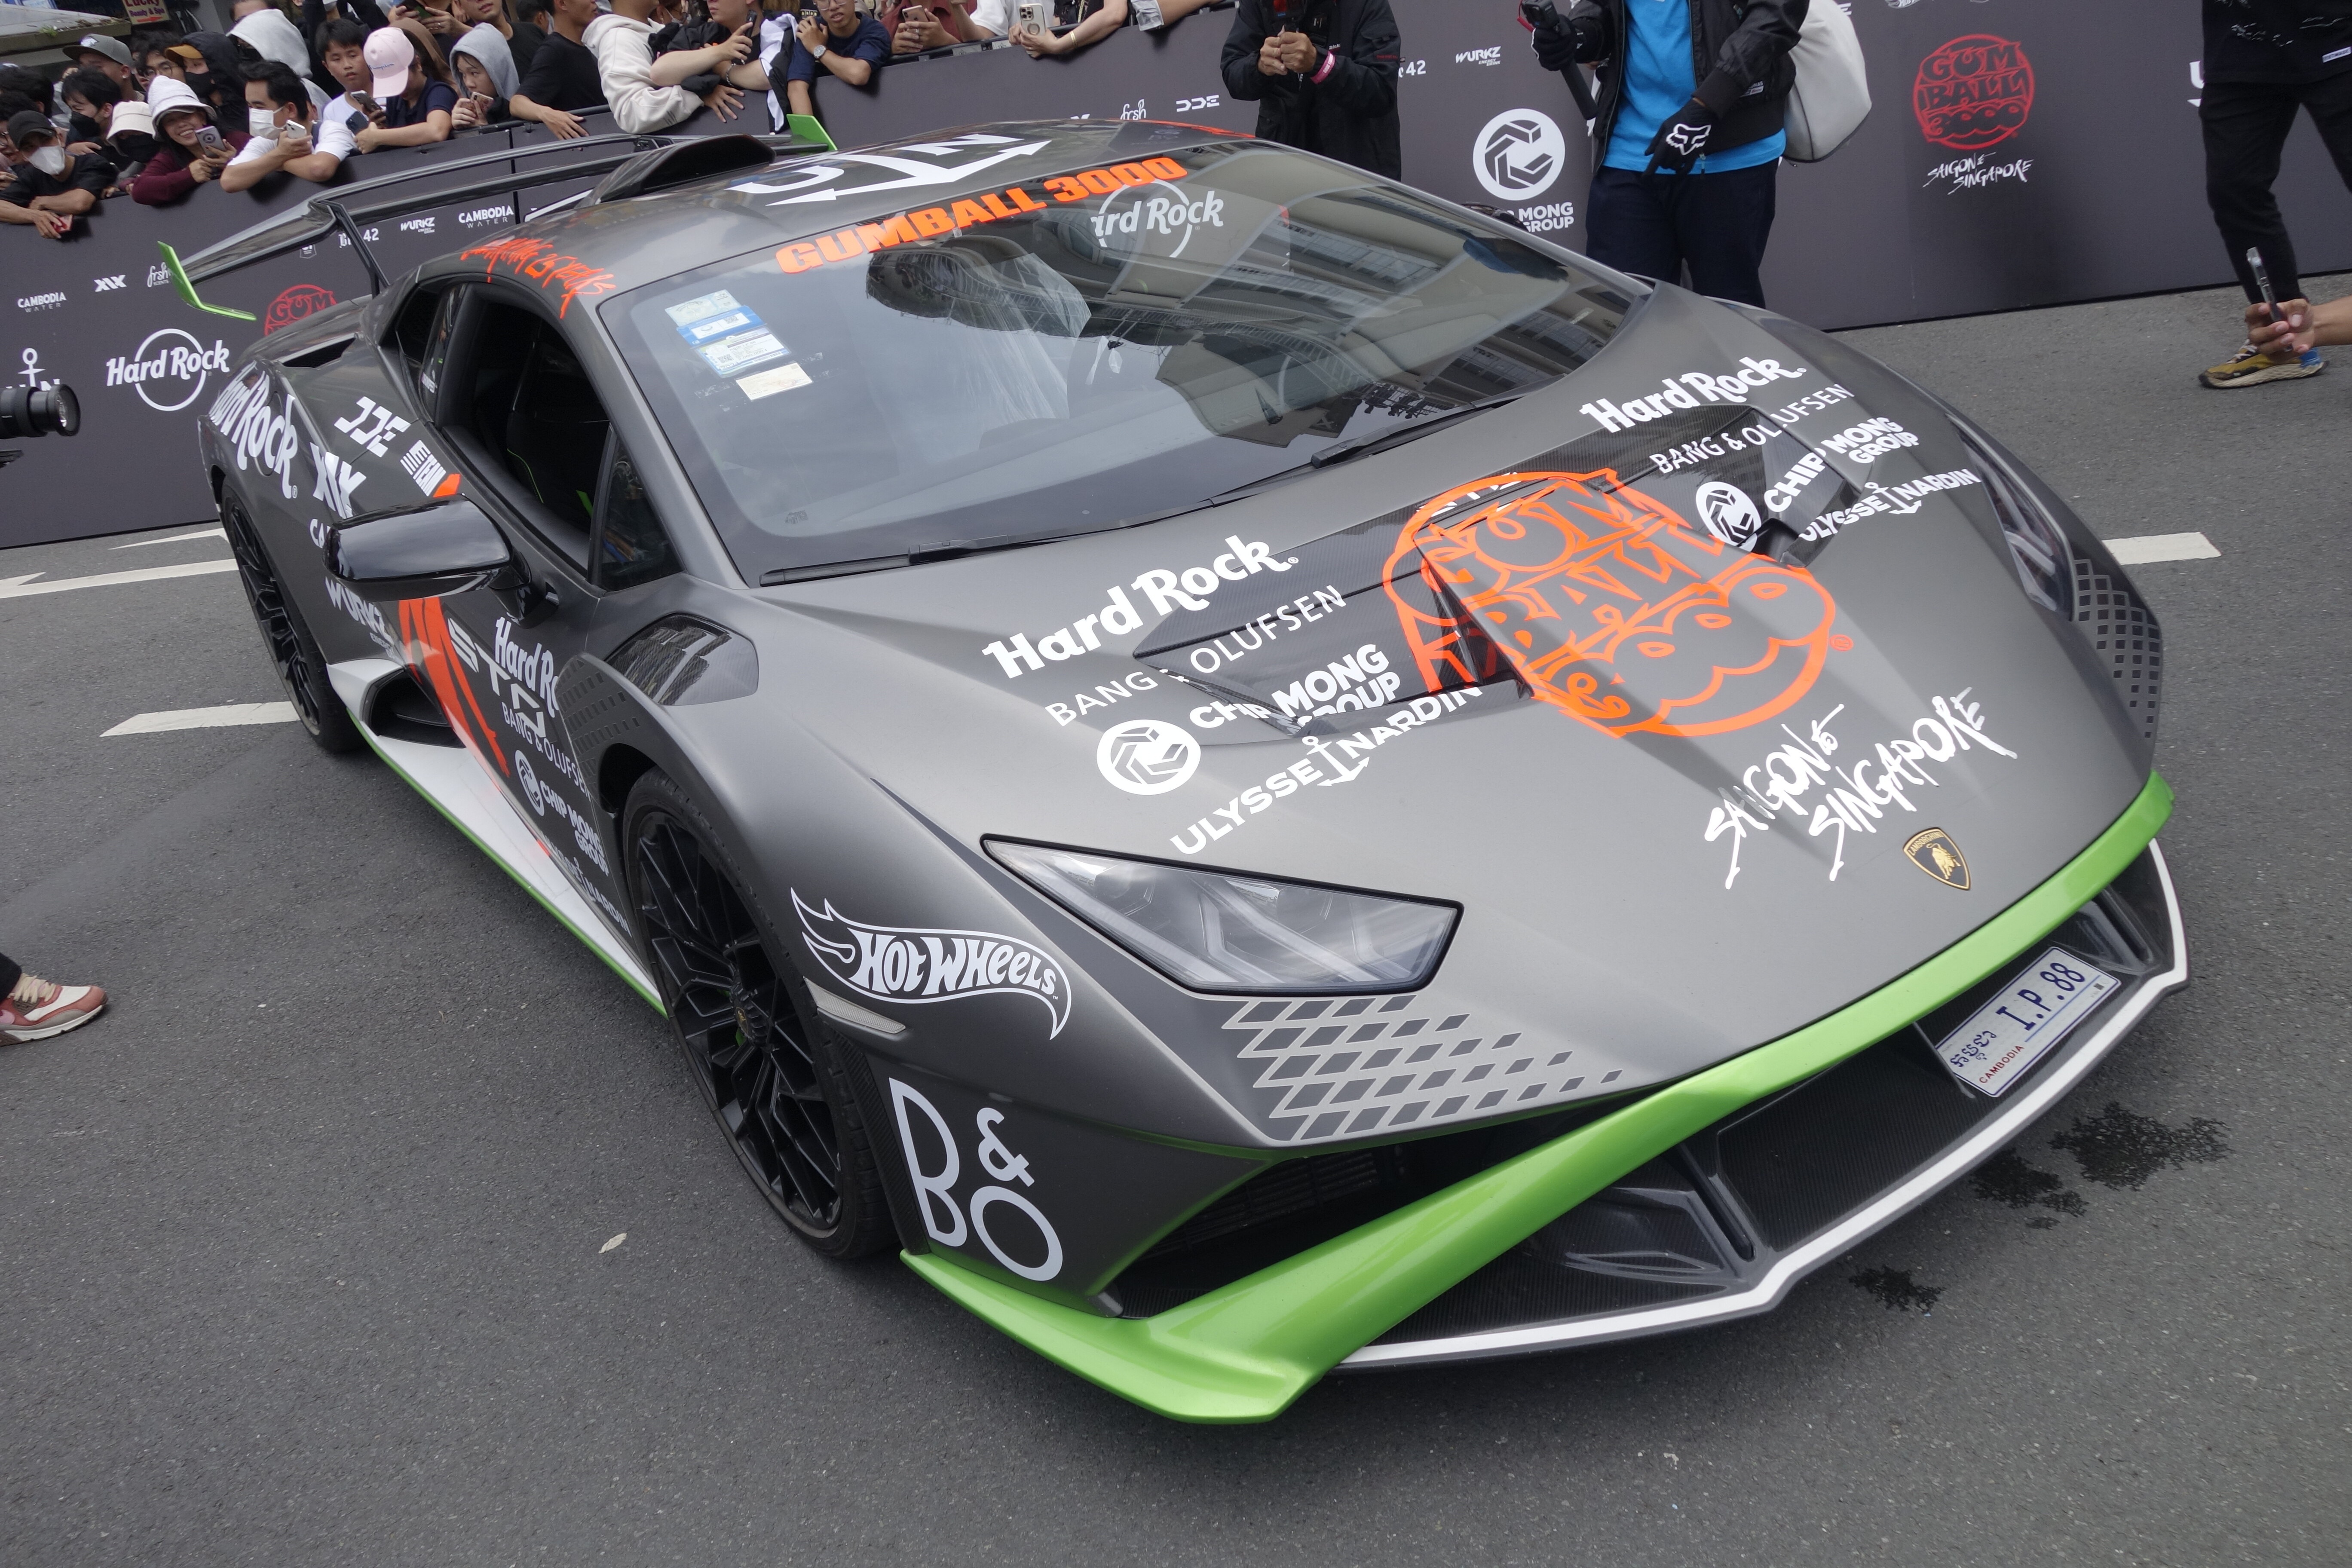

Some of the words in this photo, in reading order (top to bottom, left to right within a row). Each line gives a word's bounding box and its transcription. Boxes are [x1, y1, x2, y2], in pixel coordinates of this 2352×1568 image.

[1406, 60, 1427, 76] 42
[1455, 46, 1501, 64] WURKZ
[1922, 152, 1977, 188] SAIGON
[1947, 158, 2034, 195] SINGAPORE
[363, 228, 379, 242] 42
[400, 217, 435, 231] WURKZ
[458, 205, 514, 224] CAMBODIA
[466, 217, 508, 229] WATER
[775, 187, 1047, 274] GUMBALL
[1044, 157, 1188, 204] 3000
[1090, 201, 1142, 237] ard
[1146, 190, 1224, 234] Rock
[1519, 202, 1574, 222] MONG
[17, 292, 67, 308] CAMBODIA
[24, 302, 61, 313] WATER
[106, 349, 168, 386] Hard
[170, 340, 230, 380] Rock
[1579, 379, 1700, 433] Hard
[1680, 356, 1803, 403] Rock
[231, 370, 298, 499] Rock
[1649, 437, 1725, 474] BANG
[1721, 433, 1746, 450] &
[1742, 384, 1855, 445] OLUFSEN
[1848, 432, 1919, 463] GROUP
[1764, 448, 1826, 512] CHIP
[1821, 417, 1904, 454] MONG
[1798, 495, 1891, 542] ULYSSE
[1892, 469, 1981, 502] NARDIN
[325, 576, 395, 646] WURKZ
[982, 585, 1144, 679] Hard
[1131, 535, 1291, 617] Rock
[495, 616, 542, 692] Hard
[1045, 671, 1158, 727] BANG
[1190, 585, 1347, 673] OLUFSEN
[1271, 644, 1389, 717] MONG
[502, 701, 533, 744] BANG
[534, 730, 543, 753] &
[543, 738, 592, 802] OLUFSEN
[1170, 758, 1324, 855] ULYSSE
[1336, 687, 1483, 760] NARDIN
[1704, 723, 1831, 890] SAIGON
[1808, 686, 2018, 882] SINGAPORE
[540, 780, 567, 818] CHIP
[567, 803, 605, 858] MONG
[574, 830, 609, 877] GROUP
[1908, 831, 1945, 856] LAMBORGHINI
[1979, 1045, 2024, 1084] CAMBODIA
